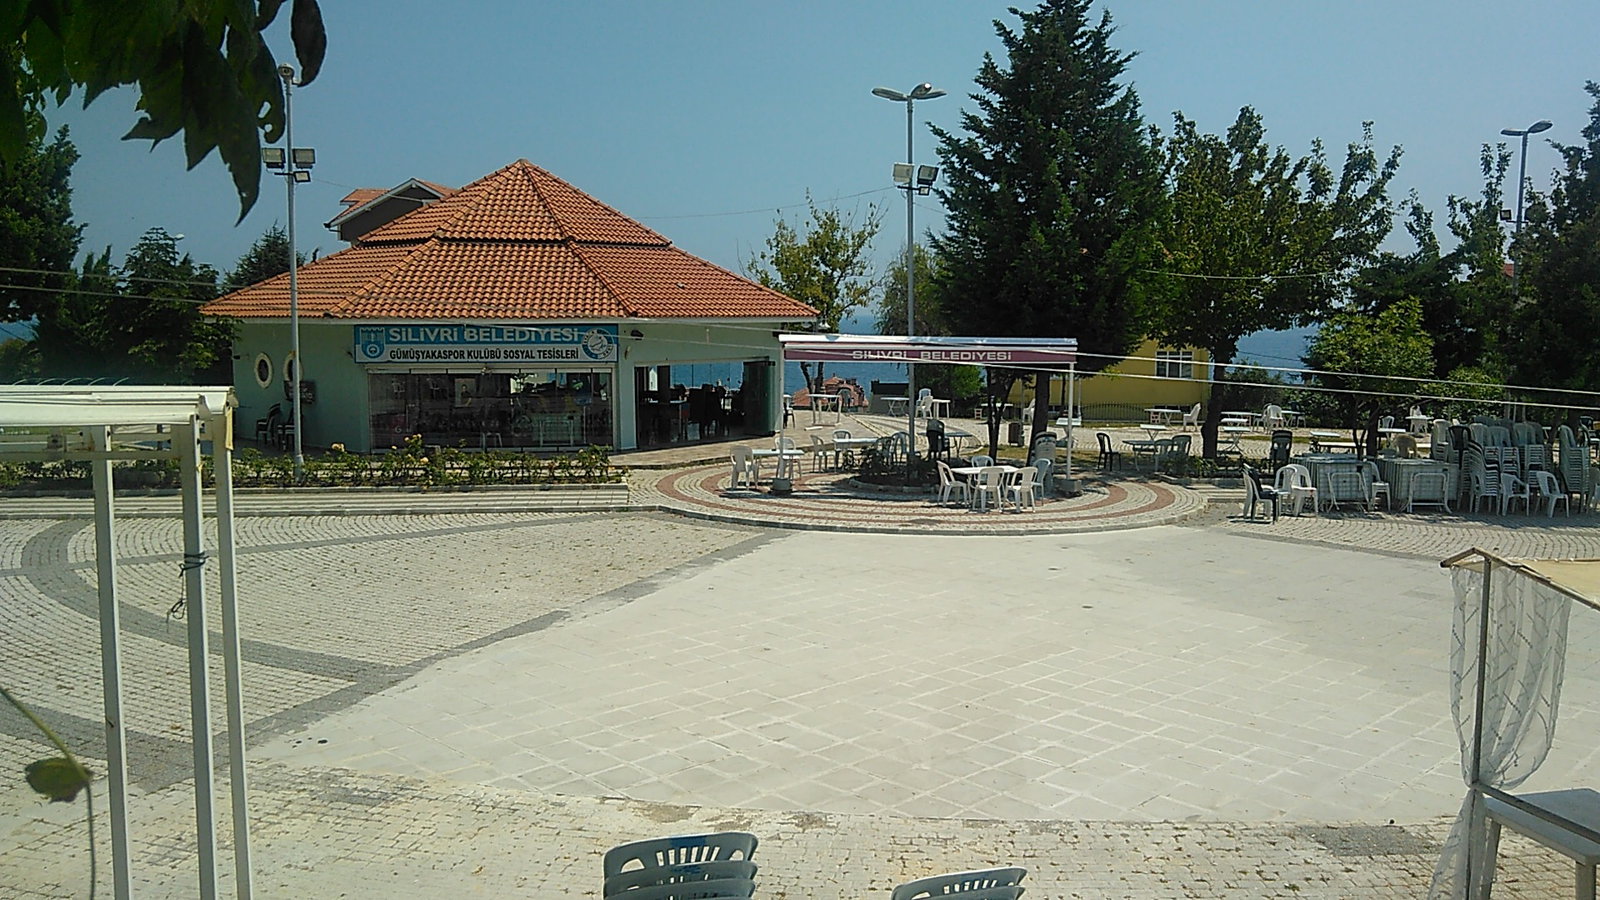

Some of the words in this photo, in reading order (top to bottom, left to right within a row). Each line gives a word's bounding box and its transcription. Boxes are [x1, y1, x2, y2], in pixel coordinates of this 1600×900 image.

[389, 348, 466, 361] GÜMÜŞYAKASPOR
[467, 348, 502, 360] KULÜBÜ
[503, 349, 536, 360] SOSYAL
[536, 347, 579, 360] TESİSLERİ
